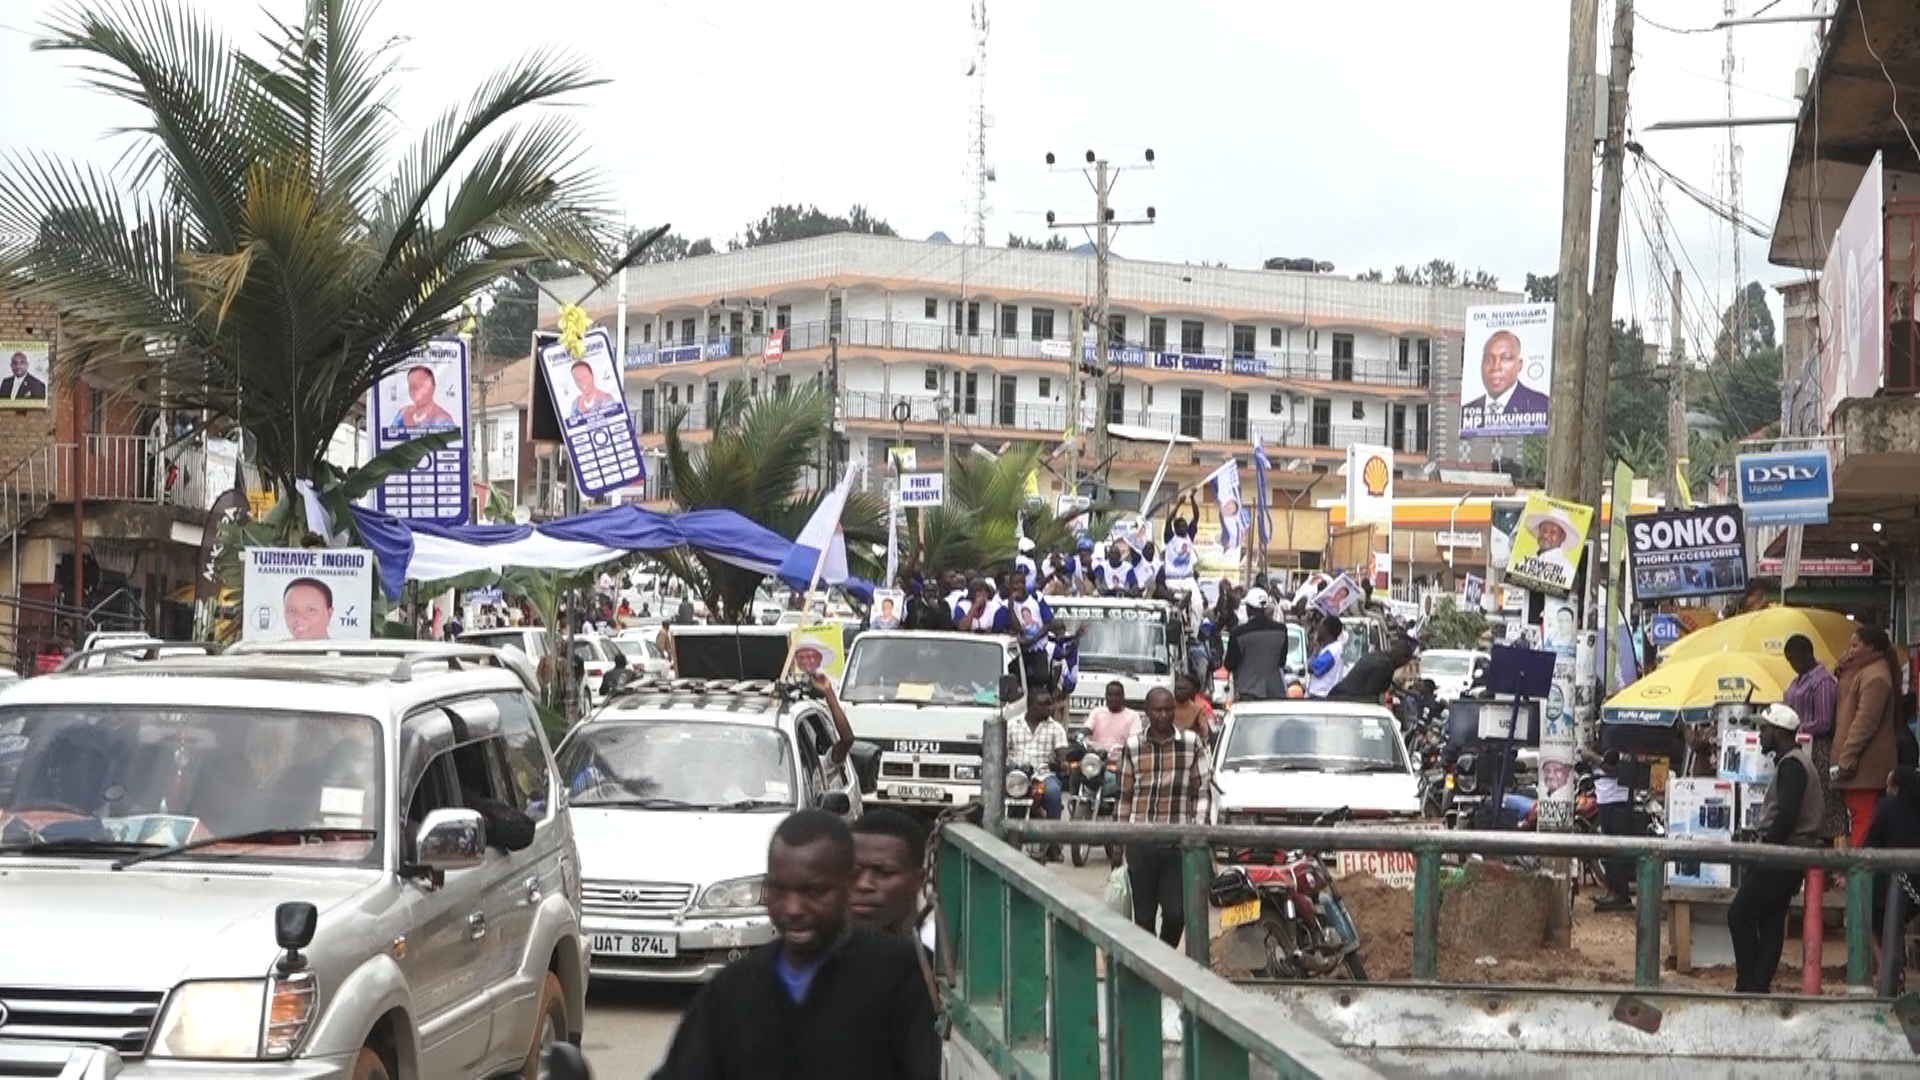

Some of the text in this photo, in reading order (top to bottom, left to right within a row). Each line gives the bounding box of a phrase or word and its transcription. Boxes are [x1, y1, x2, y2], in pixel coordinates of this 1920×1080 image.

[1491, 308, 1548, 319] NUWAGABA
[1085, 349, 1144, 364] RUUNGIRI
[1233, 358, 1267, 373] HOTEL
[1463, 407, 1482, 417] FOR
[1463, 411, 1547, 430] MP RUKUNGIRI
[910, 477, 931, 488] FREE
[1749, 484, 1783, 494] Uganda
[1634, 515, 1737, 550] SONKO
[252, 551, 364, 568] TURINAWE INGRID
[1637, 548, 1740, 565] PHONE ACCESSORIES
[1514, 563, 1567, 585] MUSEVENI
[339, 617, 359, 627] TIK
[1639, 711, 1661, 723] Agent
[894, 740, 940, 753] ISUZU
[594, 934, 668, 954] UAT 874L
